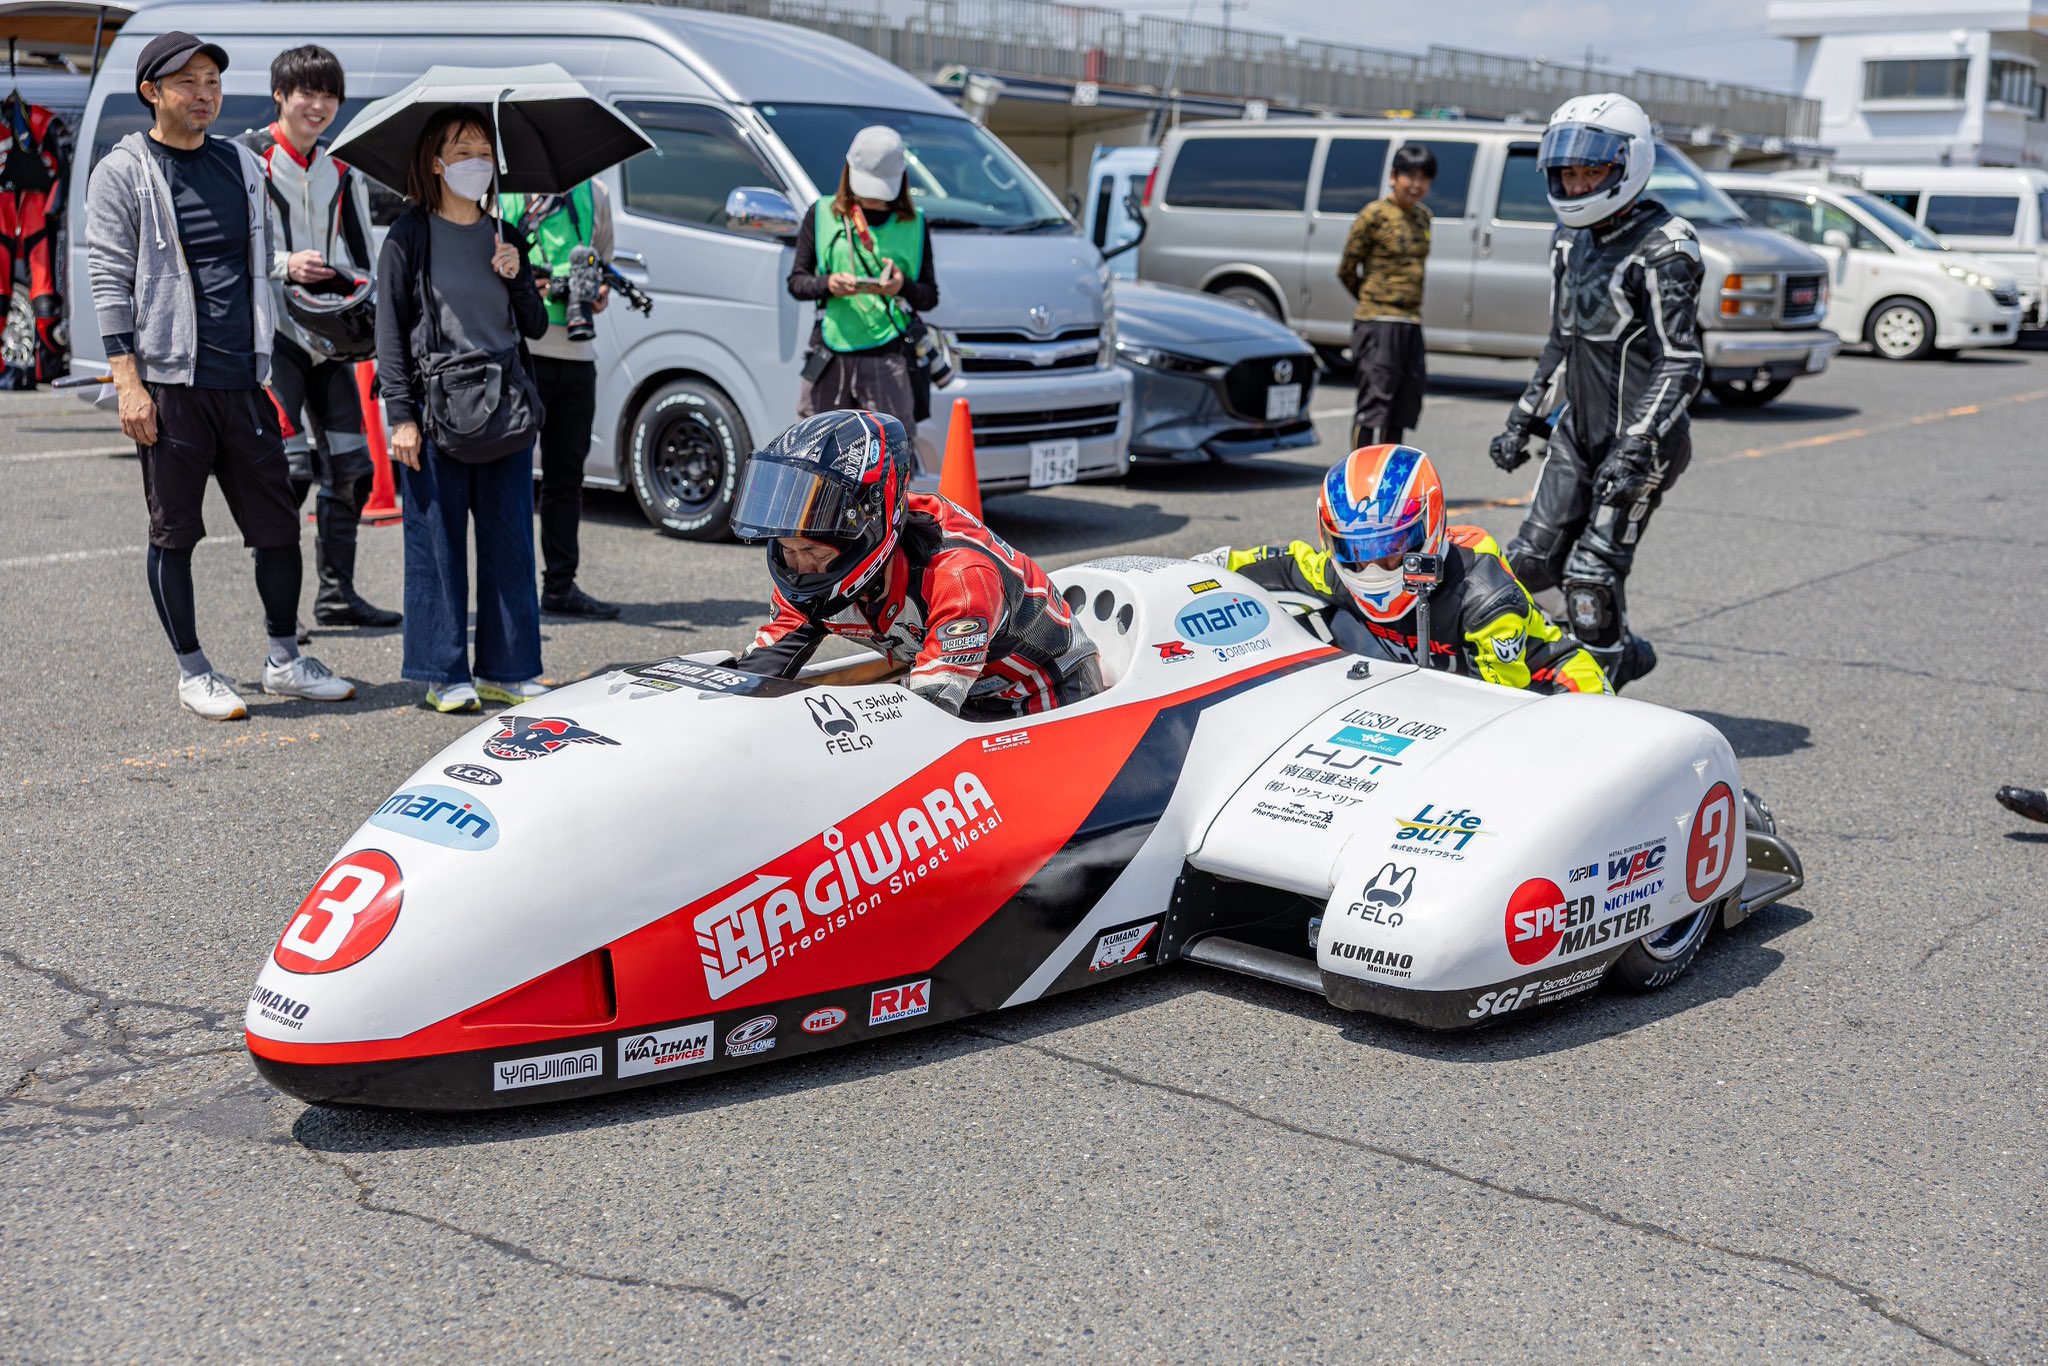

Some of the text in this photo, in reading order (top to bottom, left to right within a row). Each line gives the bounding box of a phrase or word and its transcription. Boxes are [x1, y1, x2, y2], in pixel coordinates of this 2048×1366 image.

[1181, 598, 1261, 638] marin
[1225, 638, 1272, 658] ORBITRON
[703, 669, 748, 686] TRS
[853, 691, 908, 711] T.Shikoh
[862, 708, 903, 724] T.Suki
[1340, 709, 1446, 740] LUSSO CAFE
[981, 731, 1028, 749] LS2
[983, 739, 1031, 753] HELMETS
[1295, 743, 1403, 775] HJT
[450, 766, 495, 784] LCR
[375, 793, 491, 839] marin
[1257, 801, 1322, 820] Over-the-Fence
[1412, 804, 1482, 829] Life
[1390, 843, 1465, 861] 株式会社ライフライン
[1608, 849, 1623, 859] METAL
[1695, 796, 1729, 890] 3
[704, 772, 995, 980] HAGIWARA
[771, 808, 1003, 967] Precision Sheet Metal
[1603, 878, 1665, 913] NICHIMOLY
[281, 863, 386, 962] 3
[1514, 895, 1595, 943] SPEED
[1102, 928, 1140, 947] KUMANO
[1558, 903, 1652, 957] MASTER
[1330, 941, 1414, 969] KUMANO
[1366, 963, 1412, 978] Motorsport
[1540, 961, 1607, 992] Sacred Ground
[251, 984, 310, 1020] UMANO
[871, 981, 928, 1017] RK
[1468, 981, 1542, 1019] SGF
[260, 1007, 303, 1030] Motorsport
[809, 1016, 840, 1030] HEL
[871, 1005, 928, 1024] TAKASAGO CHAIN
[624, 1034, 709, 1063] WALTHAM
[653, 1048, 705, 1065] SERVICES
[500, 1053, 598, 1085] YAJIMA
